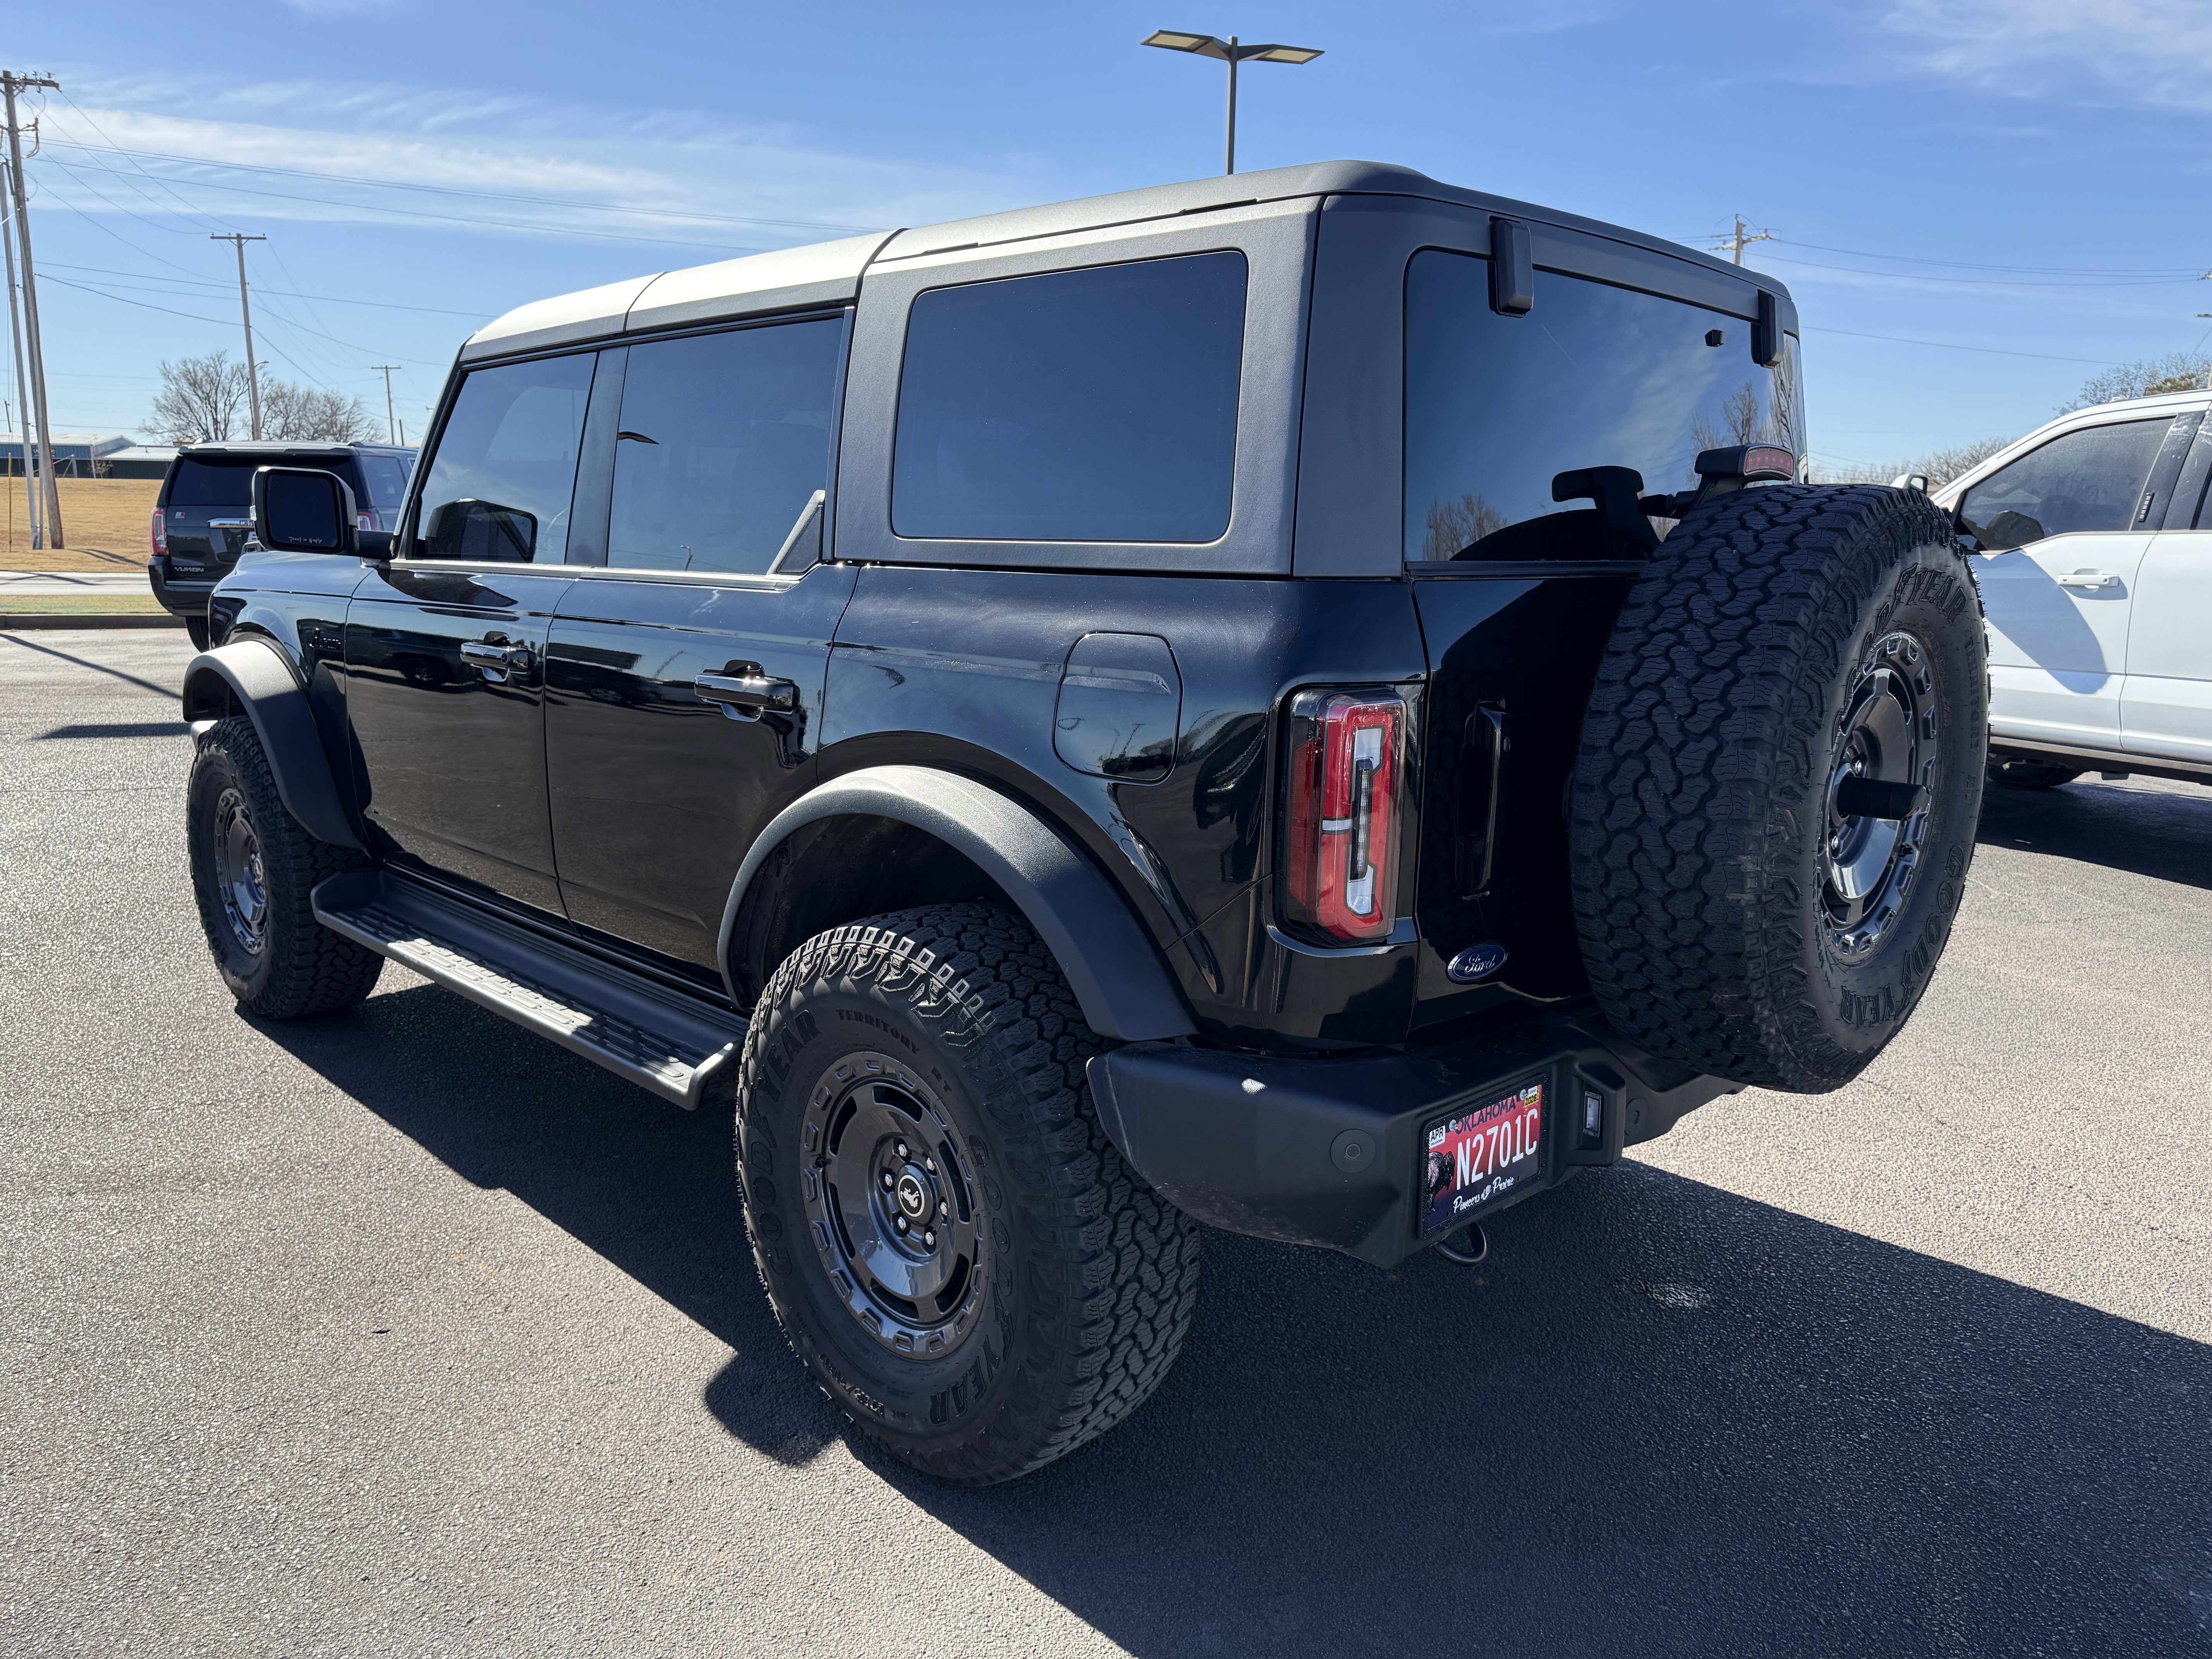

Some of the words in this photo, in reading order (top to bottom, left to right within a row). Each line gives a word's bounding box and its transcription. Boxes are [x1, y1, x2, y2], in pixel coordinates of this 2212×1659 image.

[1464, 951, 1496, 973] Ford
[836, 1008, 921, 1055] TERRITORY
[1431, 1127, 1443, 1142] APR
[1455, 1097, 1516, 1135] OKLAHOMA
[1456, 1108, 1538, 1190] N2701C
[1453, 1195, 1480, 1214] Pioneers
[1492, 1176, 1514, 1194] Prairie
